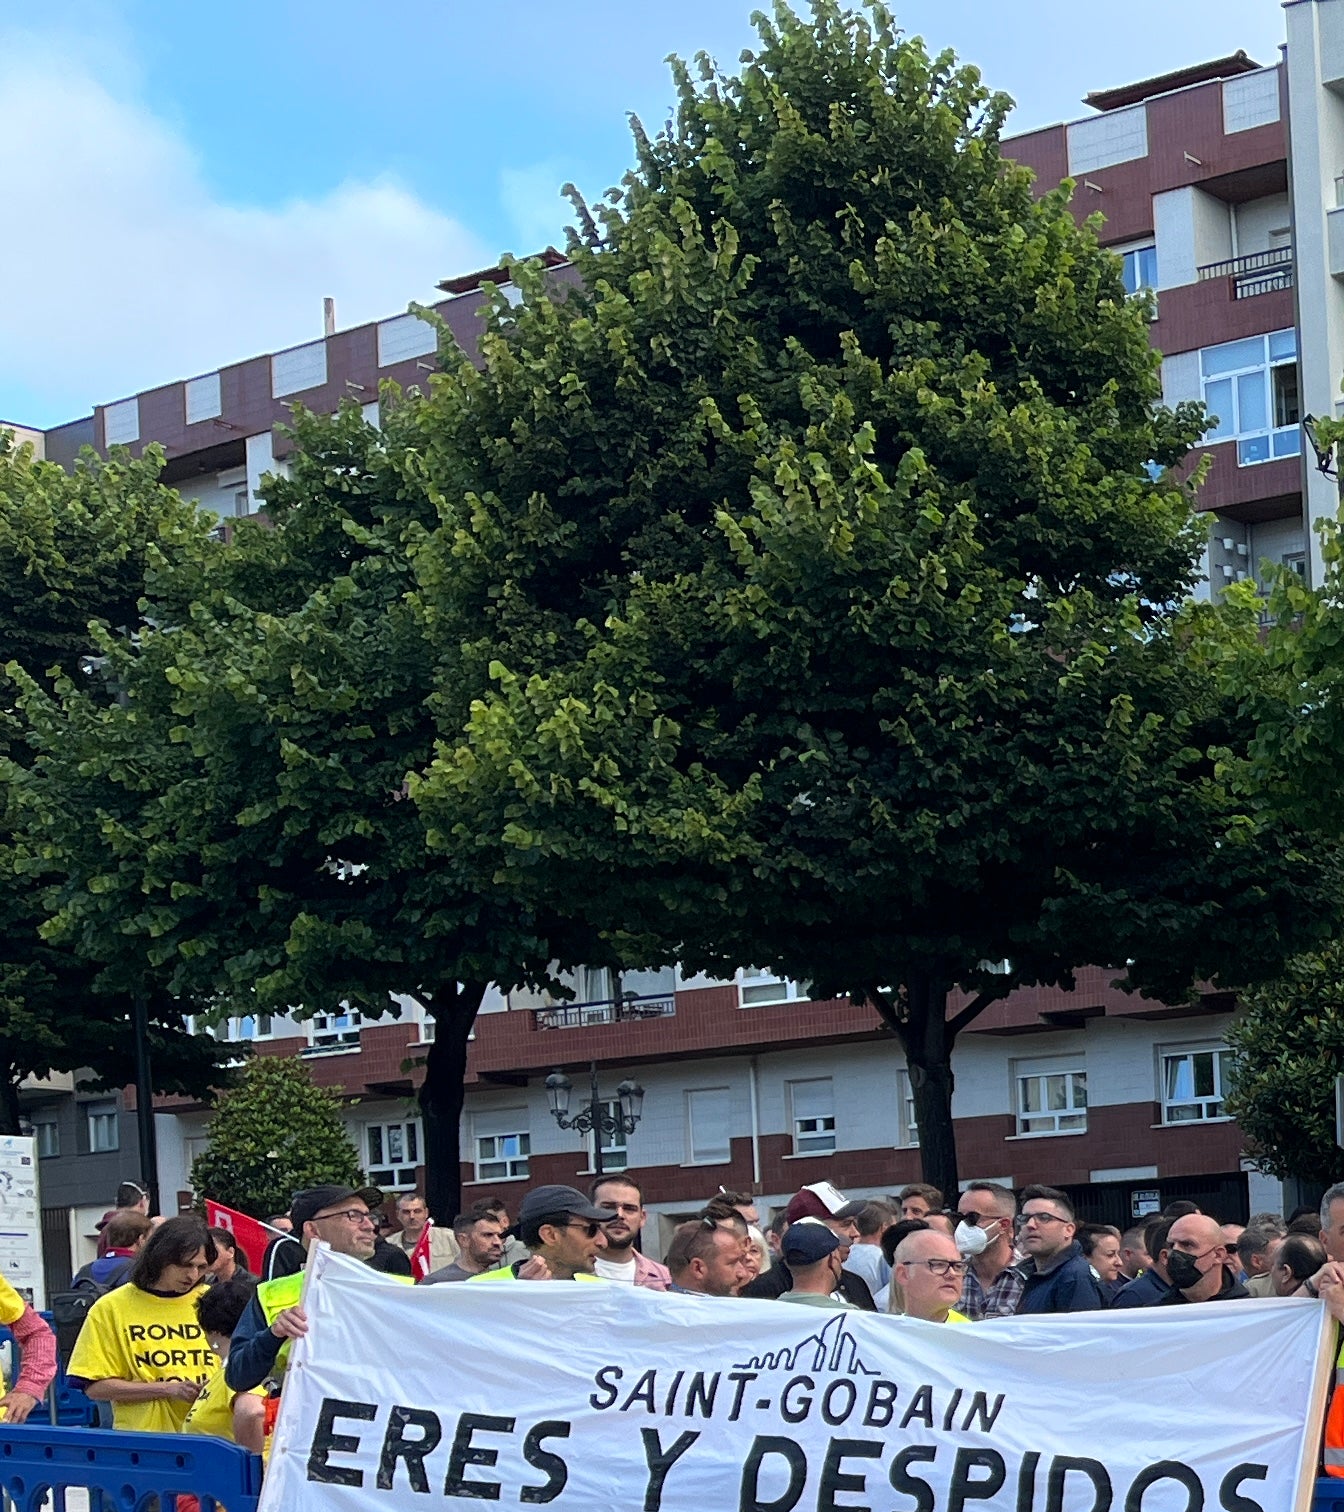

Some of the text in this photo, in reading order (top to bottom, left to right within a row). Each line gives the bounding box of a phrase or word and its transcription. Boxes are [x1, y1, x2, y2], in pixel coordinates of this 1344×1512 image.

[135, 1349, 214, 1368] NORTE
[590, 1365, 1005, 1433] SAINT-GOBAIN
[307, 1397, 571, 1504] ERES
[640, 1427, 700, 1512] Y
